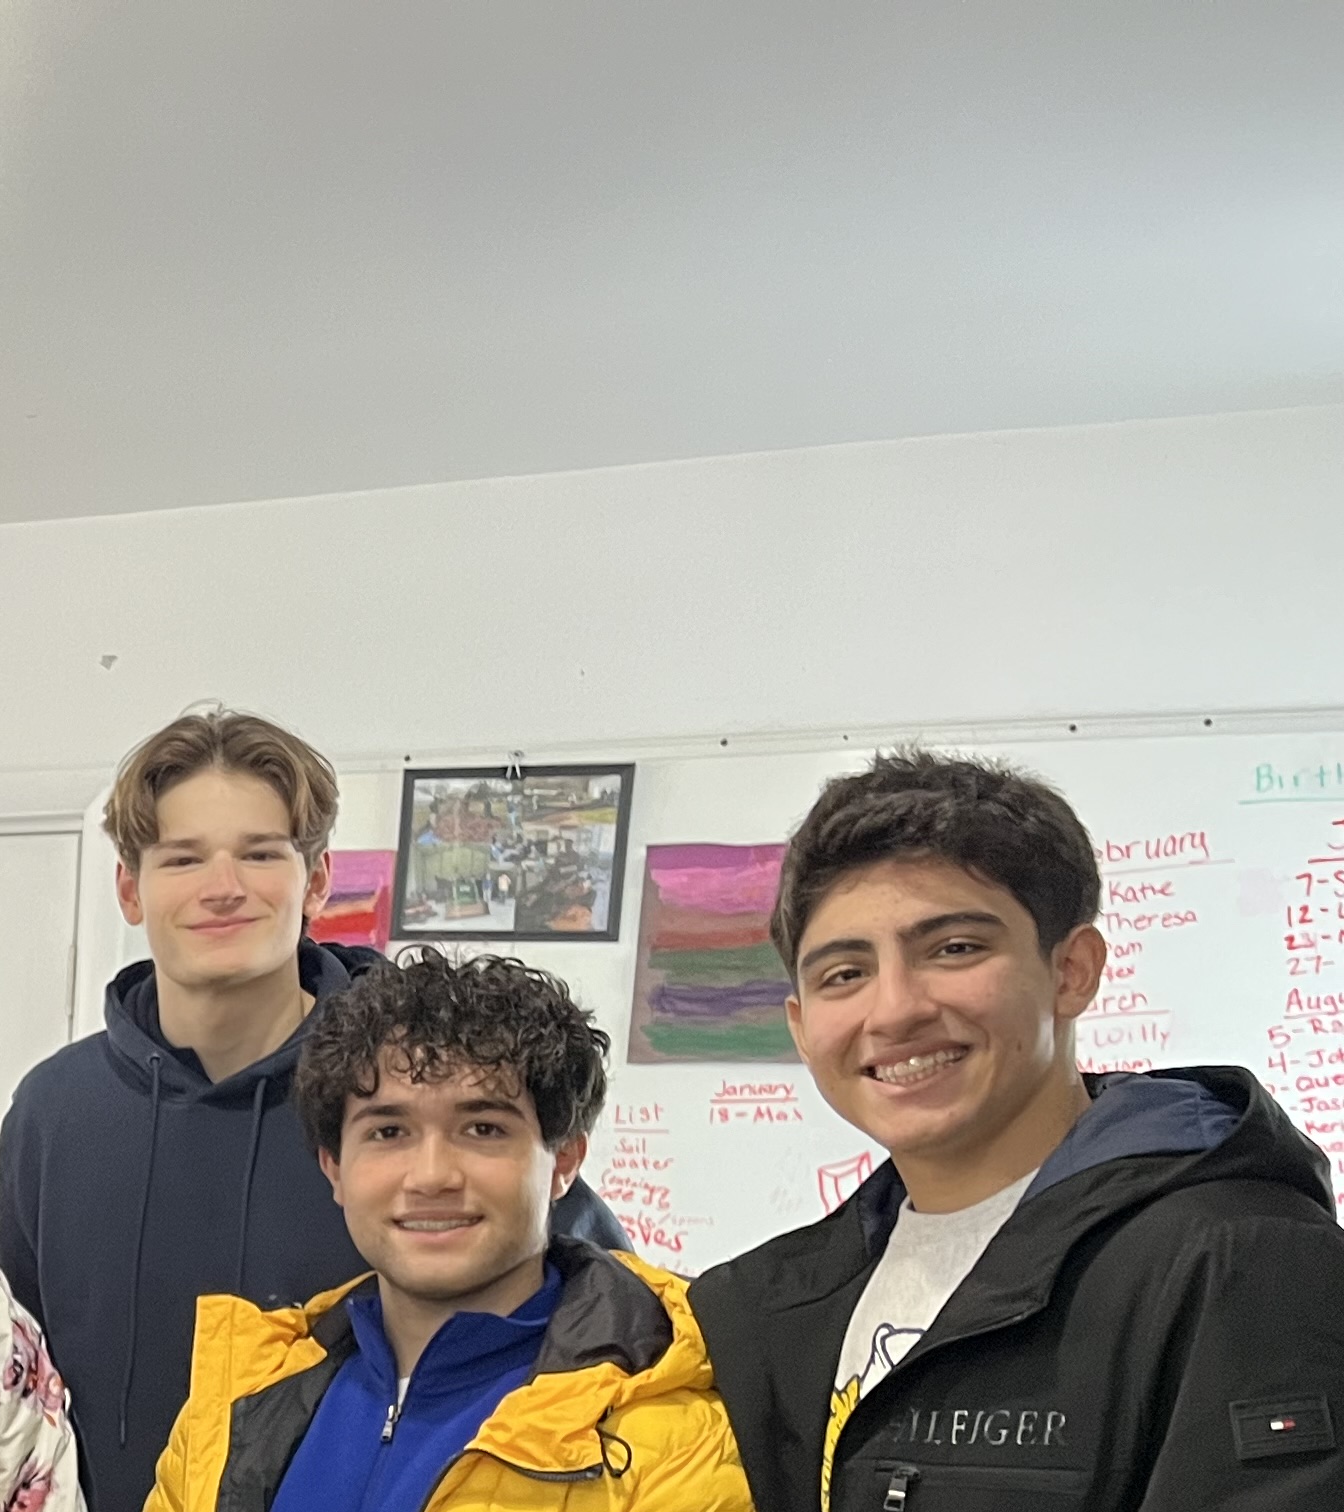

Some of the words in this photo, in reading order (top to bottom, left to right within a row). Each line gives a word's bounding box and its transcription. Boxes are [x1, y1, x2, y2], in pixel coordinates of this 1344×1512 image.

[1096, 831, 1210, 860] bruary
[1105, 909, 1198, 933] Theresa
[1085, 990, 1149, 1013] arch
[715, 1079, 795, 1102] January
[615, 1102, 664, 1125] List
[611, 1156, 675, 1172] water
